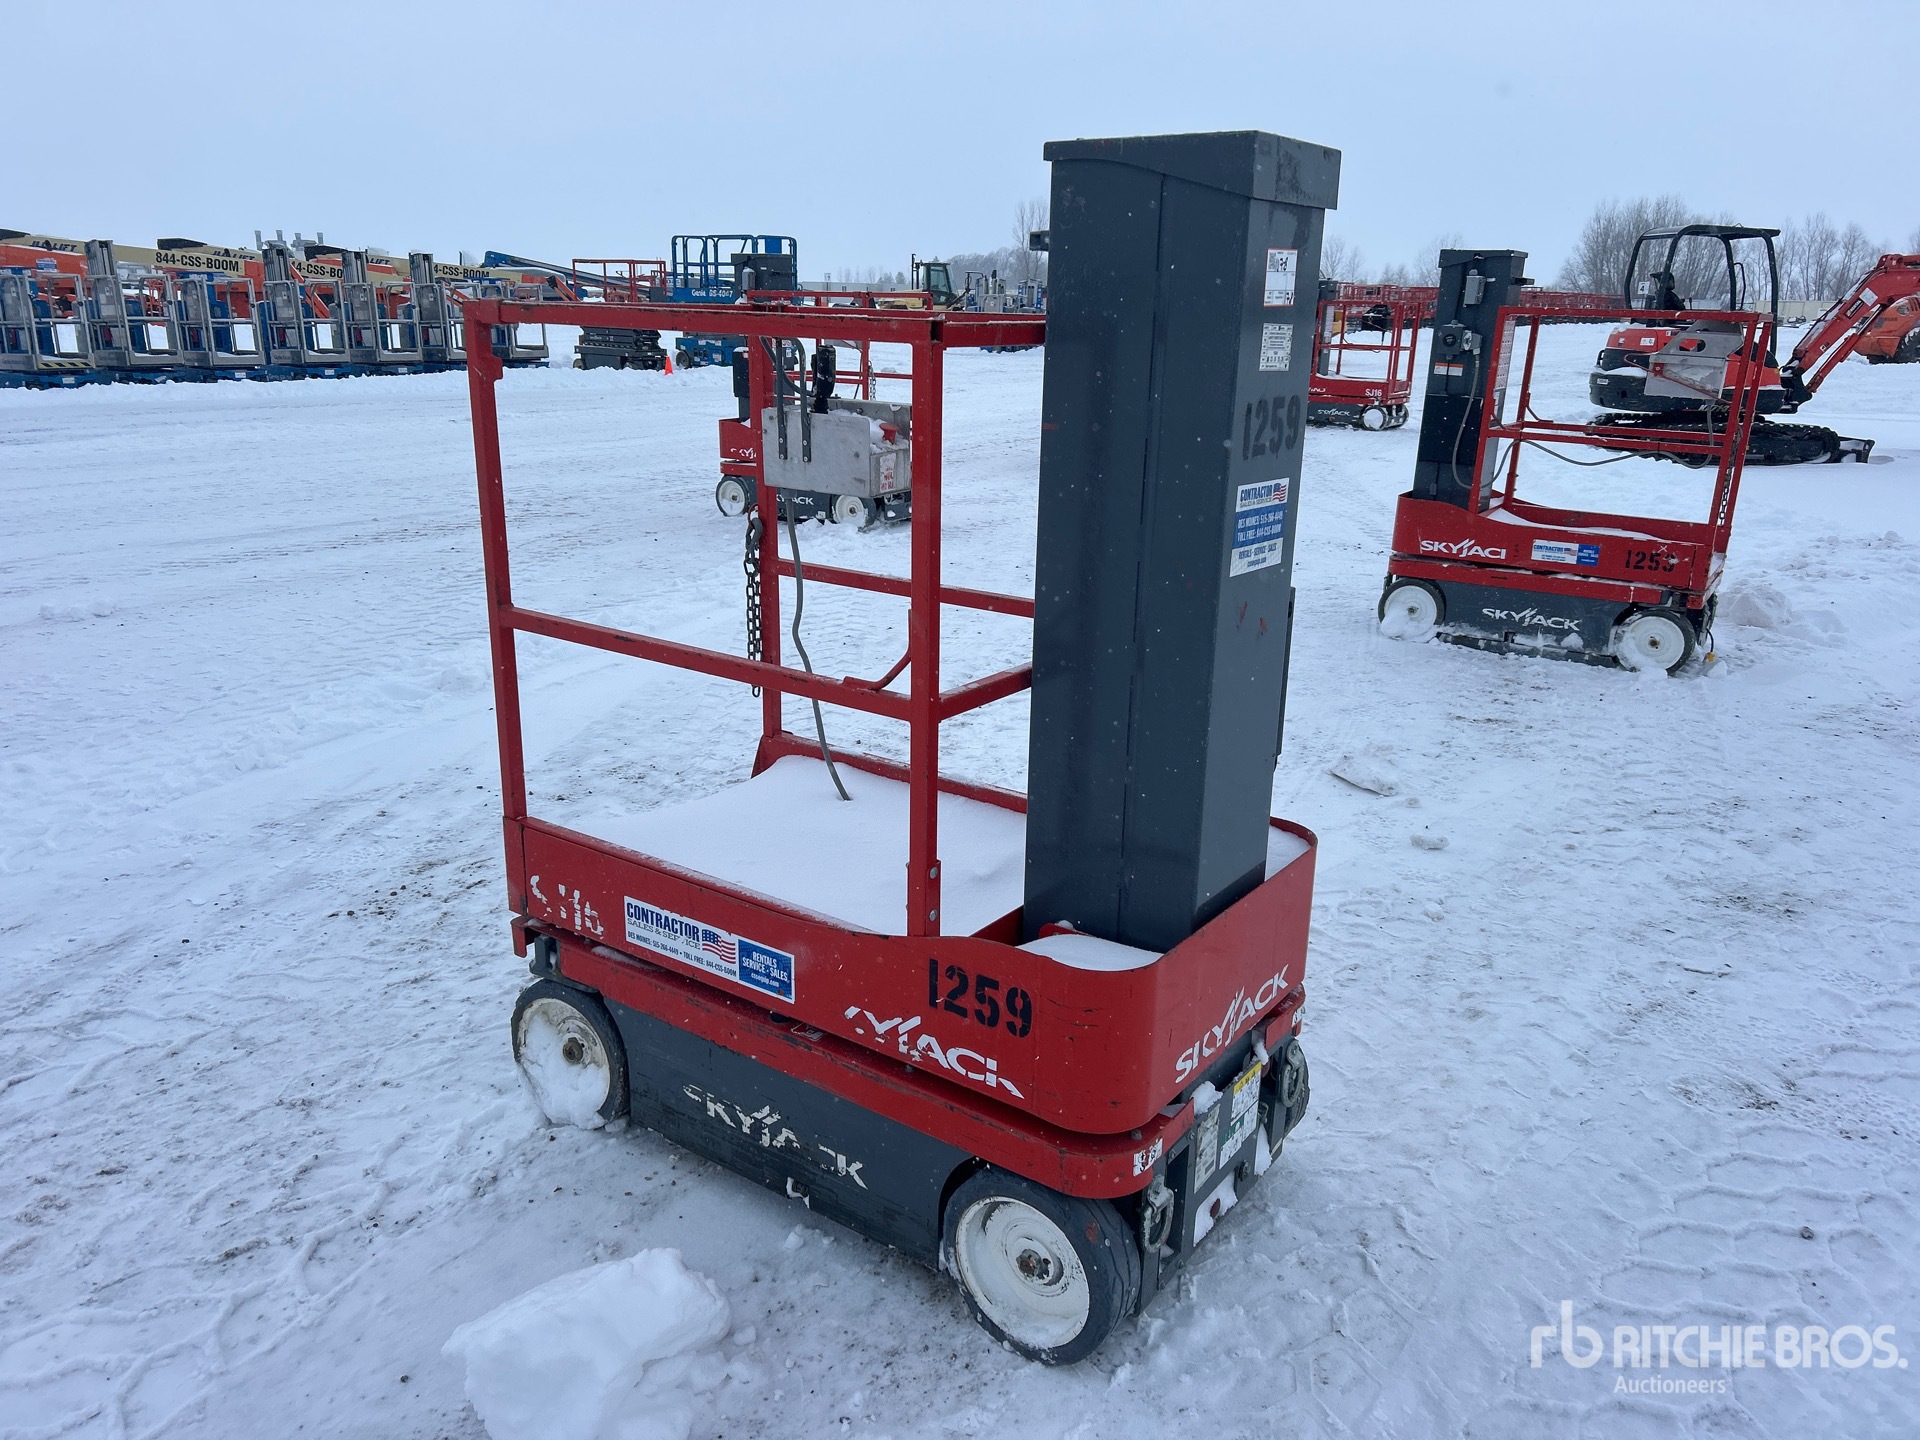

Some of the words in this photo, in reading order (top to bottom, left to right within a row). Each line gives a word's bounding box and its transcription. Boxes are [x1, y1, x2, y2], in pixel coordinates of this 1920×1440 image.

[156, 252, 239, 272] 844-CSS-BOOM
[1365, 388, 1382, 397] SJ16
[1242, 394, 1301, 461] 1259
[1482, 607, 1580, 631] SKYJACK
[626, 902, 700, 942] CONTRACTOR
[627, 917, 654, 933] SALES
[742, 956, 766, 973] SERVICE
[752, 951, 777, 968] RENTALS
[928, 958, 1033, 1038] 1259
[1175, 964, 1289, 1084] SKYJACK
